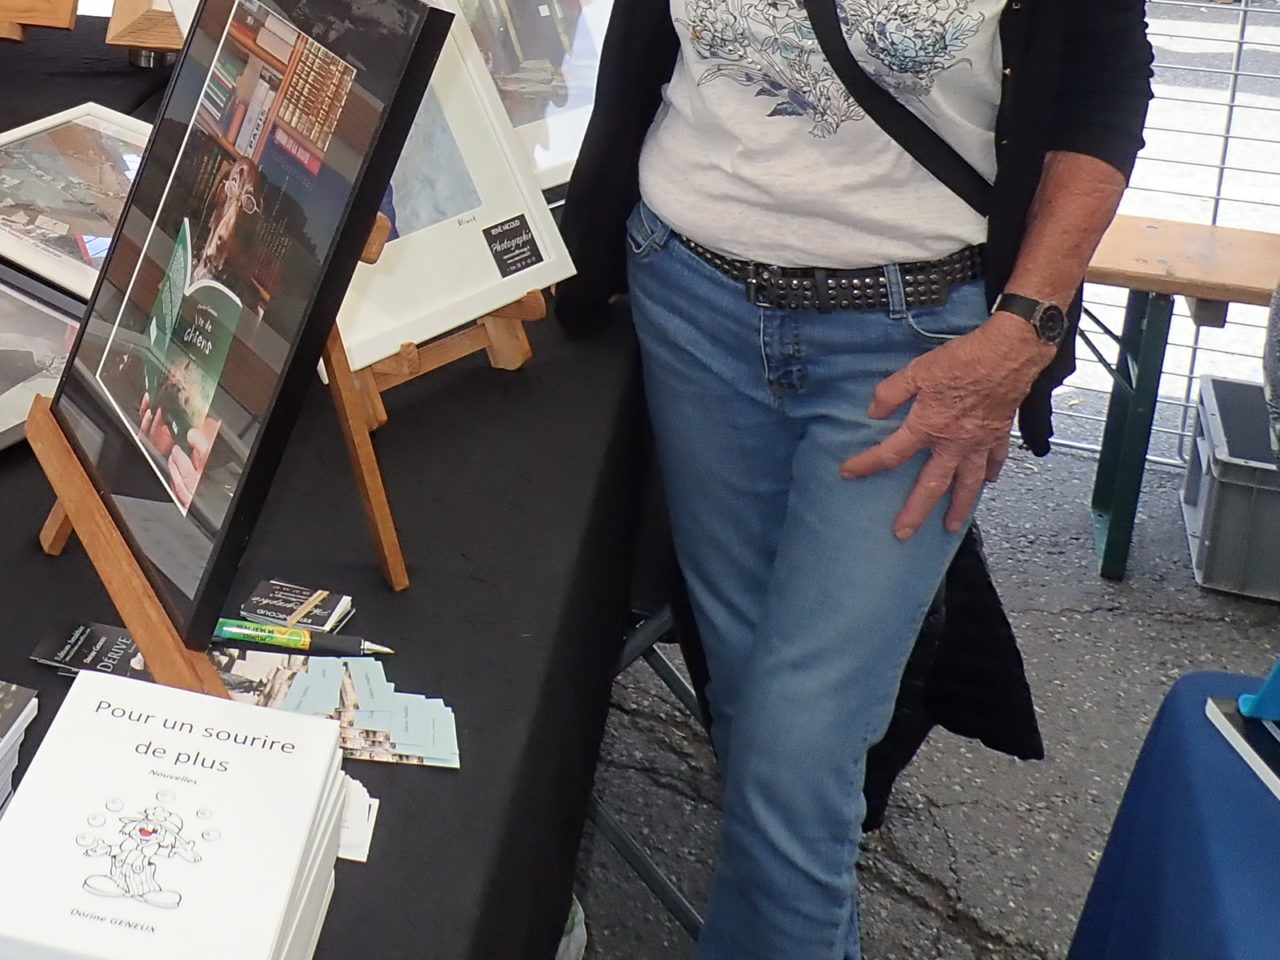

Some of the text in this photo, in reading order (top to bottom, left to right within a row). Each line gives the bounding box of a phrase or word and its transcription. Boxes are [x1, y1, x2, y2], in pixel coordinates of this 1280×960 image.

[248, 110, 267, 152] PARIS
[184, 325, 213, 356] chiens
[96, 636, 133, 672] DÉRIVE
[96, 700, 297, 755] Pour un sourire
[134, 740, 231, 774] de plus
[148, 769, 198, 785] Nouvelles
[69, 907, 158, 934] Dorine GENEUX
